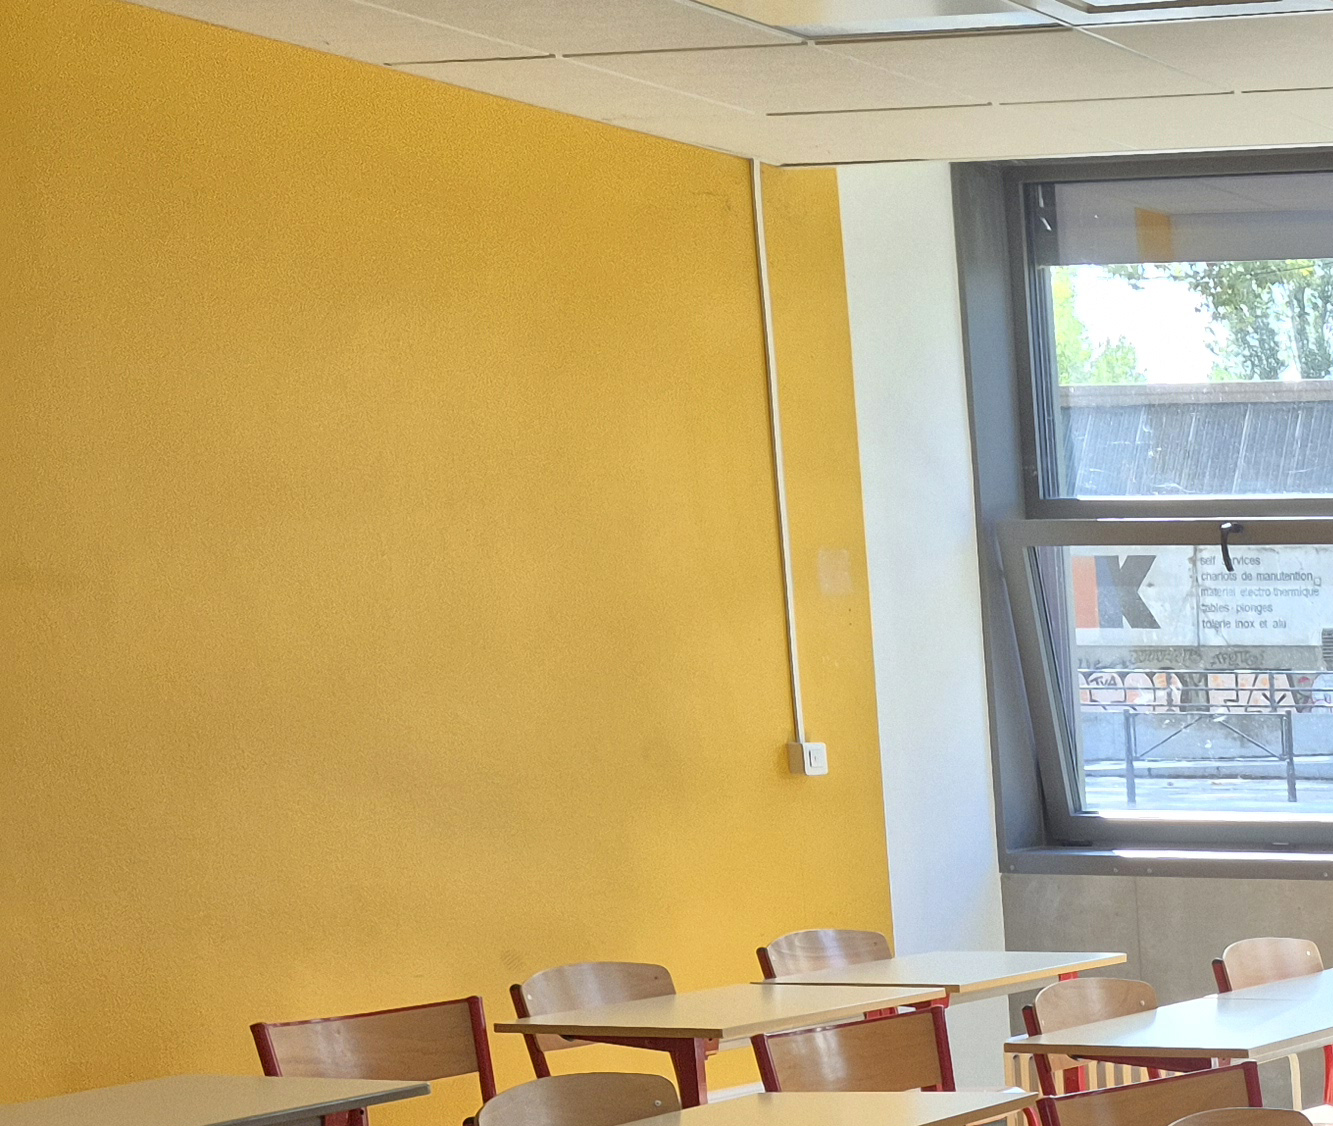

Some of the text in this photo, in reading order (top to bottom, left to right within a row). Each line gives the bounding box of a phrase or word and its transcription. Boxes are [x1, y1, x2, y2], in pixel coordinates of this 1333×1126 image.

[1222, 556, 1262, 566] rvices
[1241, 572, 1253, 581] de
[1256, 571, 1314, 582] manutention
[1235, 619, 1255, 629] inox
[1259, 620, 1268, 629] et
[1272, 618, 1287, 629] alu
